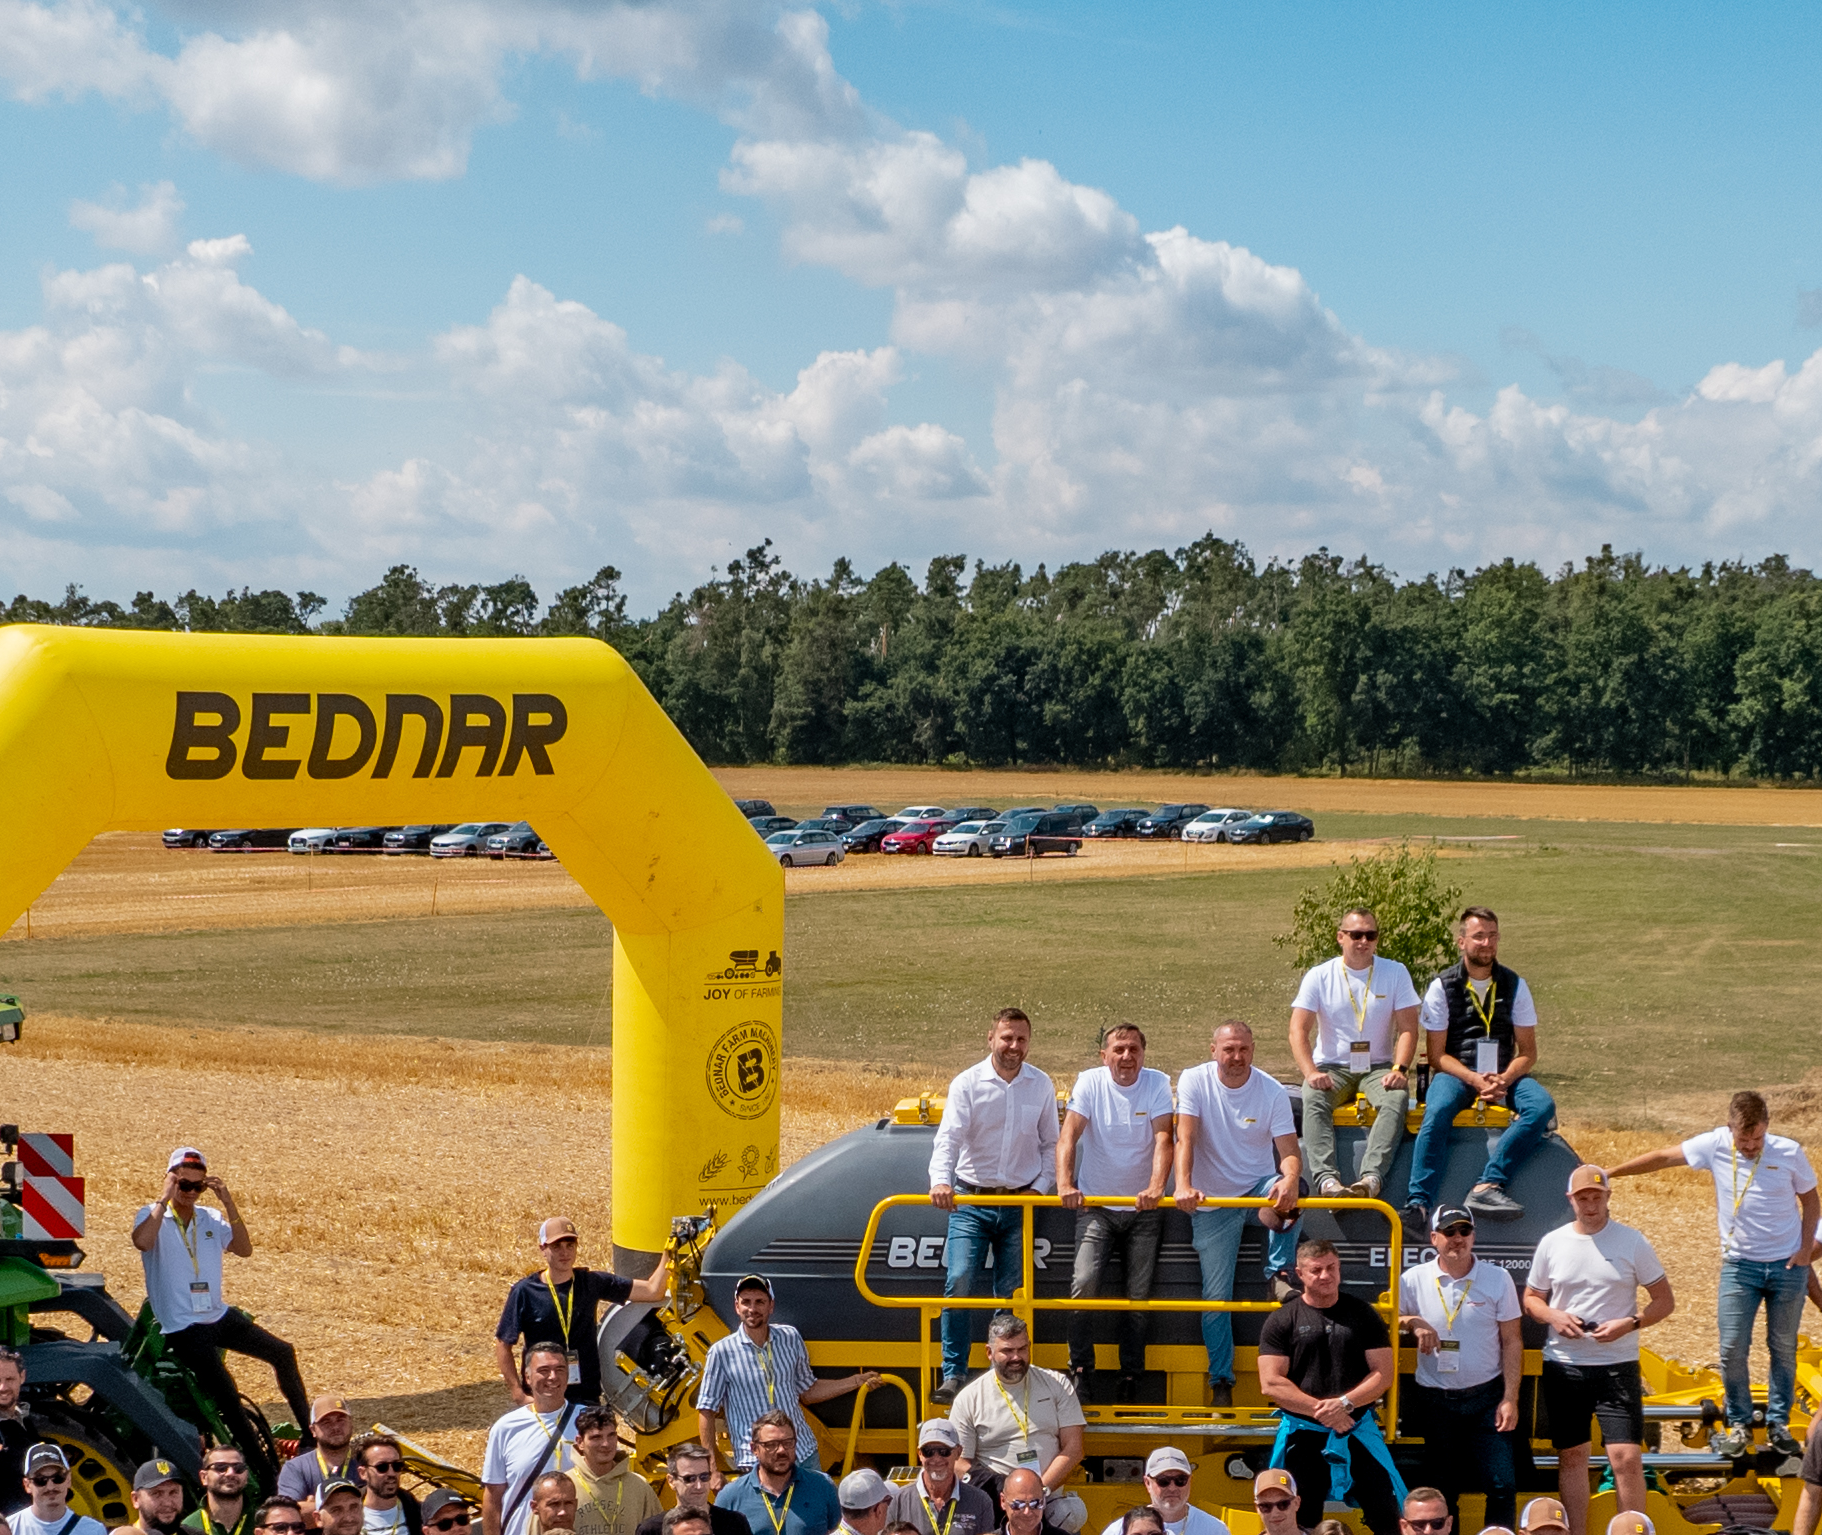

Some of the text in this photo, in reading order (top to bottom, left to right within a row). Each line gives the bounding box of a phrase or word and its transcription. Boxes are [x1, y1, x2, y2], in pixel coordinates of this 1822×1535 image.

[165, 690, 568, 781] BEDNAR
[703, 988, 731, 1000] JOY
[734, 988, 749, 1000] OF
[1499, 1259, 1532, 1270] 12000
